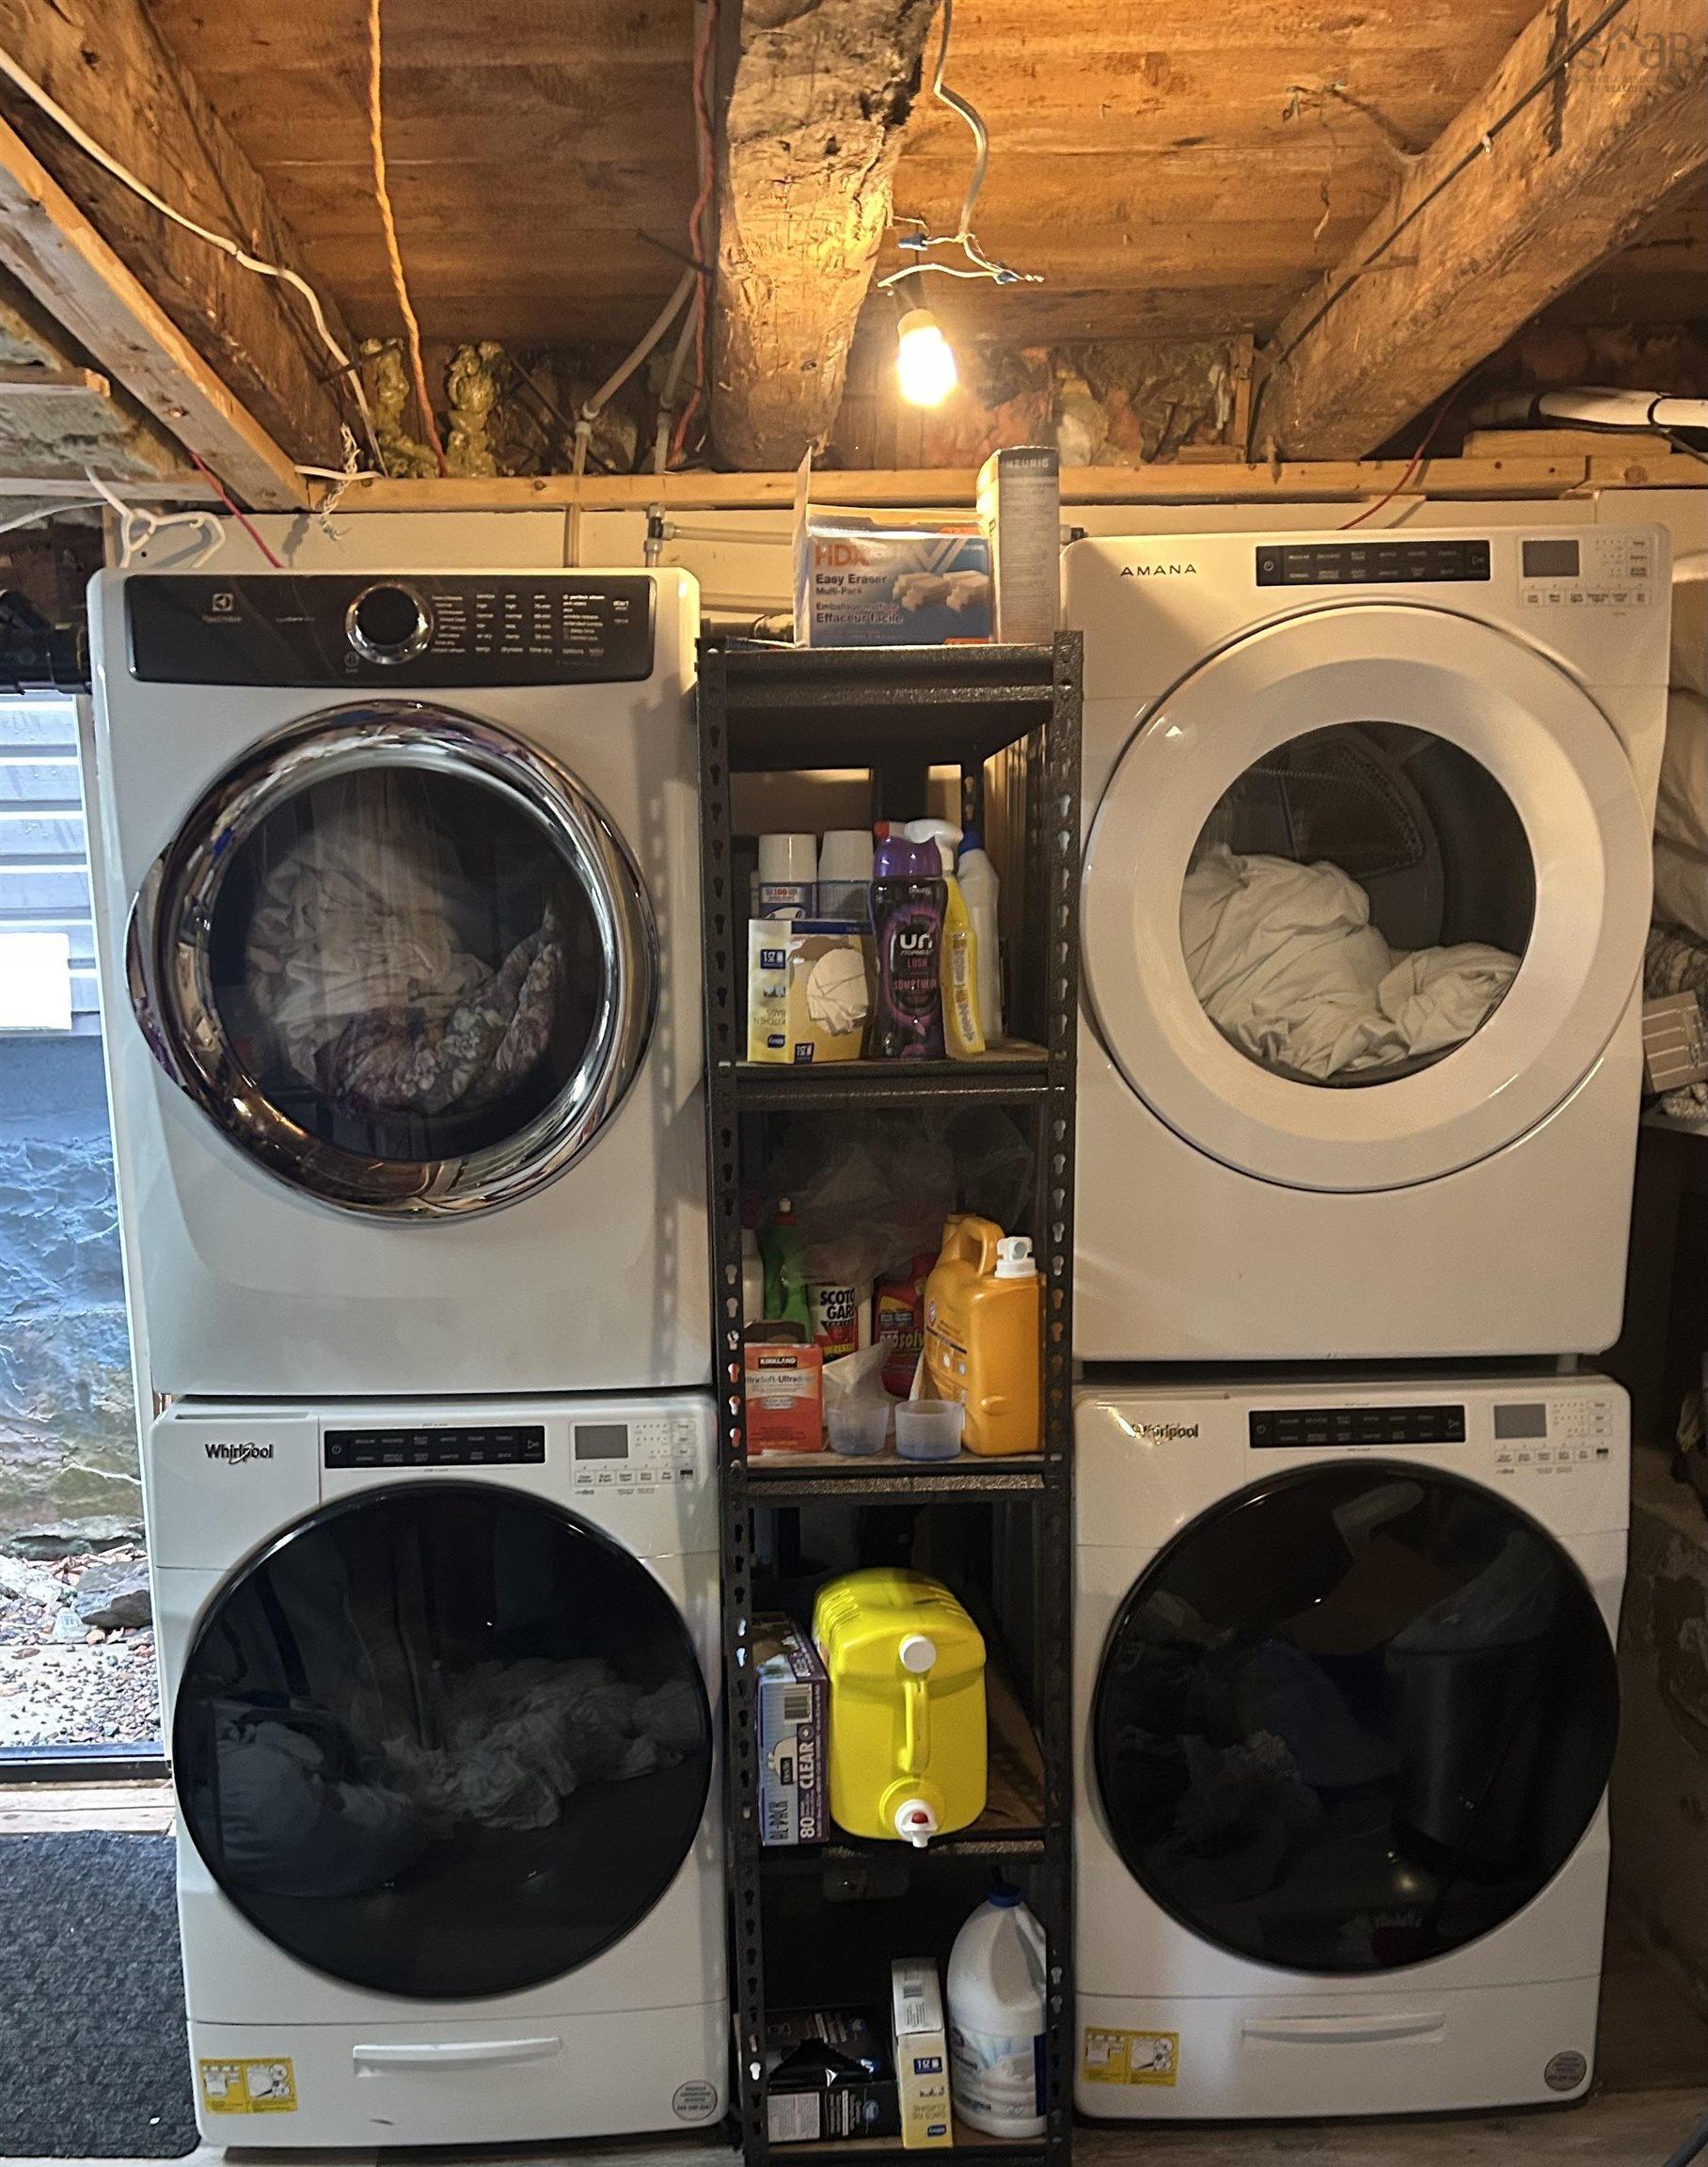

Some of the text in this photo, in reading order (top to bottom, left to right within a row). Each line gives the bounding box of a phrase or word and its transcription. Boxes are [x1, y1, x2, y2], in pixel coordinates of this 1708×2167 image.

[814, 544, 870, 566] HDX
[1120, 563, 1196, 577] AMANA
[815, 574, 888, 586] Easy Eraser
[815, 587, 862, 595] Multi-Pack
[827, 1304, 855, 1320] GAR
[1131, 1422, 1199, 1441] Whirlpool
[204, 1443, 274, 1463] Whirlpool
[799, 1741, 814, 1790] CLEAR
[799, 1816, 815, 1839] 80
